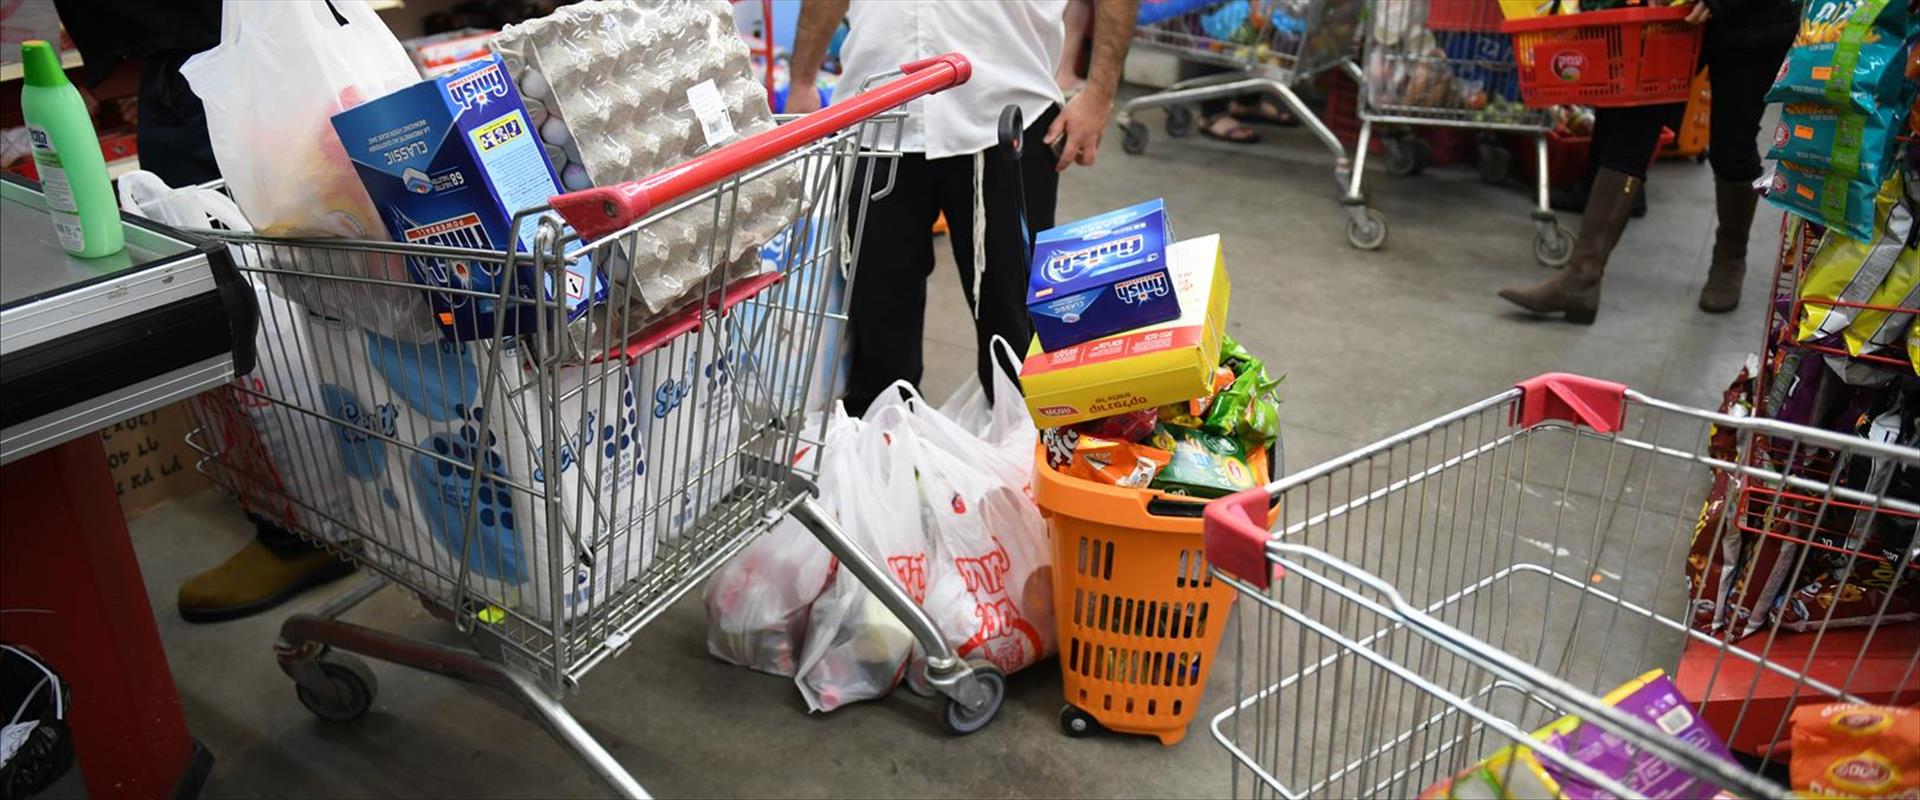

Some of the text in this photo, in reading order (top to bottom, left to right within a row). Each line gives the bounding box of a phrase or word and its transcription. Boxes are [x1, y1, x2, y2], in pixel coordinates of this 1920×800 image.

[449, 66, 508, 109] finish
[384, 141, 428, 165] CLASSIC
[449, 170, 464, 186] 68
[415, 219, 464, 236] POWERBALL
[1051, 234, 1143, 273] finish
[1115, 272, 1169, 304] finish
[1089, 396, 1148, 414] קורנפלקס
